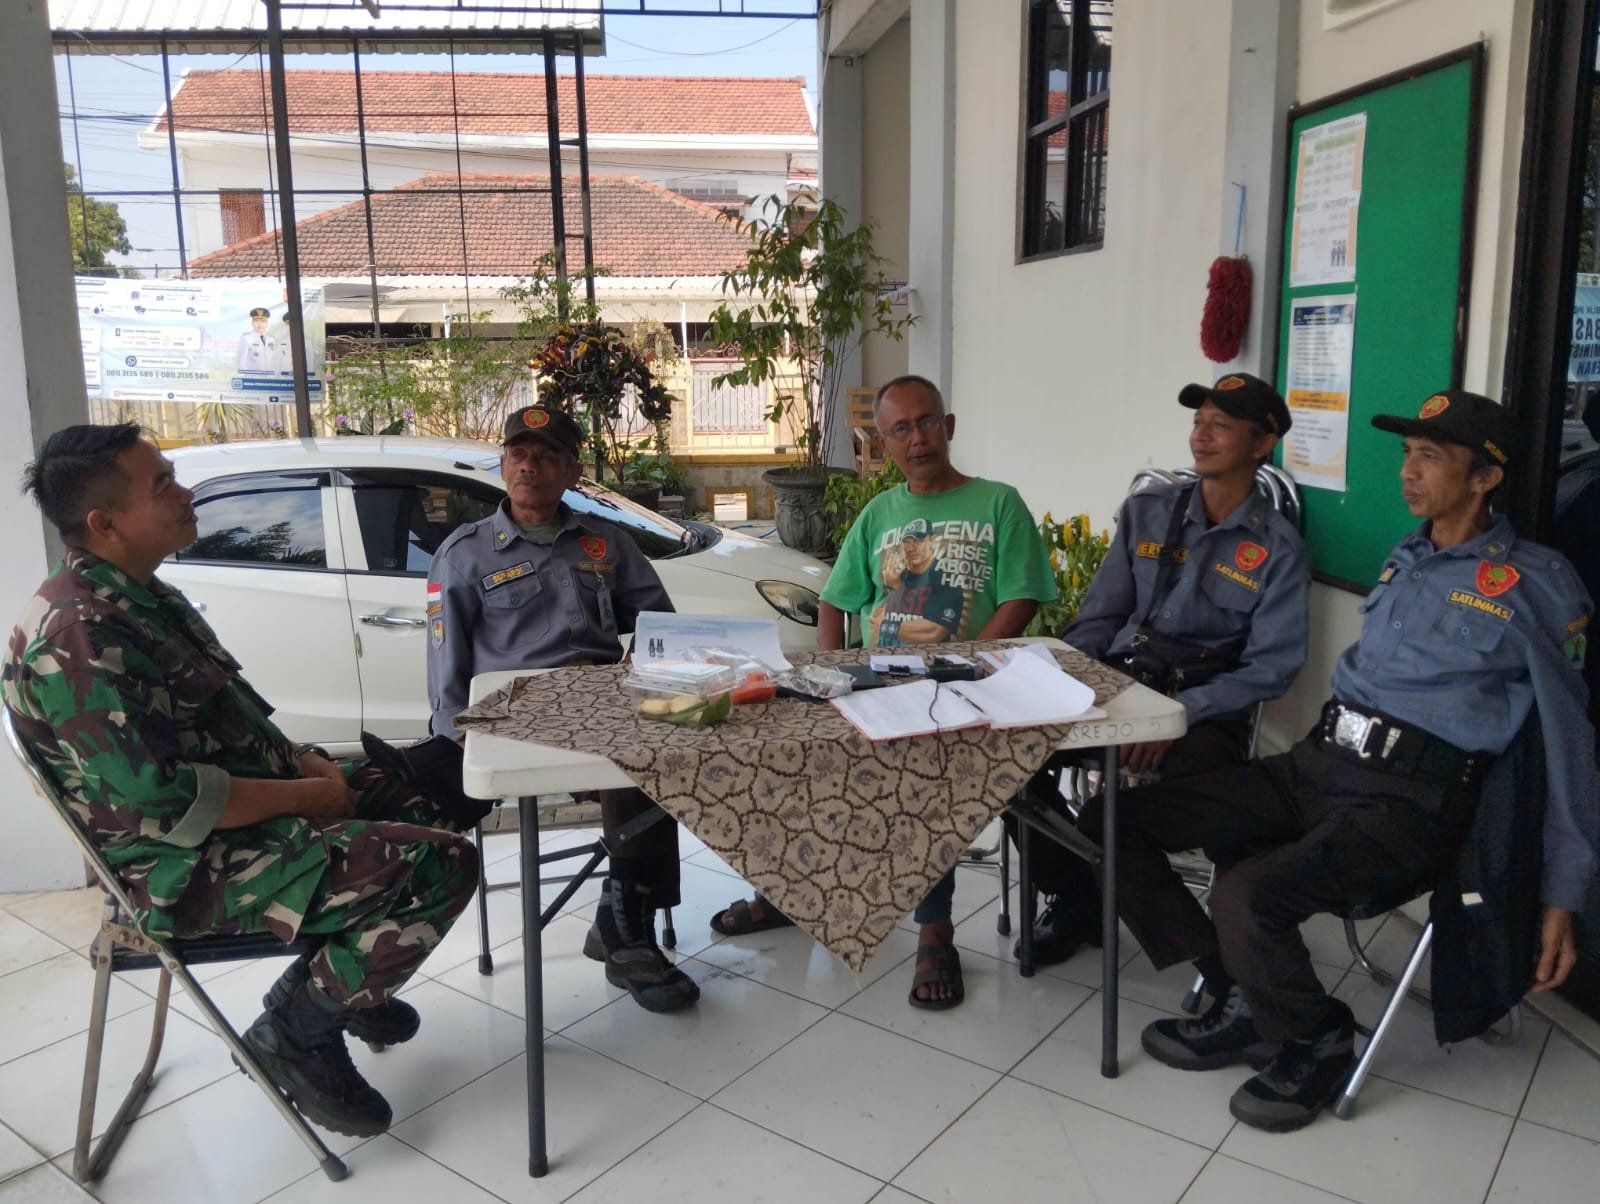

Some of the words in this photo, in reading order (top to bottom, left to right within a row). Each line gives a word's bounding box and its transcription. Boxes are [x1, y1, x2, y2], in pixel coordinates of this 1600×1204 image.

[946, 543, 988, 564] RISE
[935, 558, 993, 580] ABOVE
[941, 572, 985, 593] HATE
[1450, 591, 1509, 620] SATLINMAS
